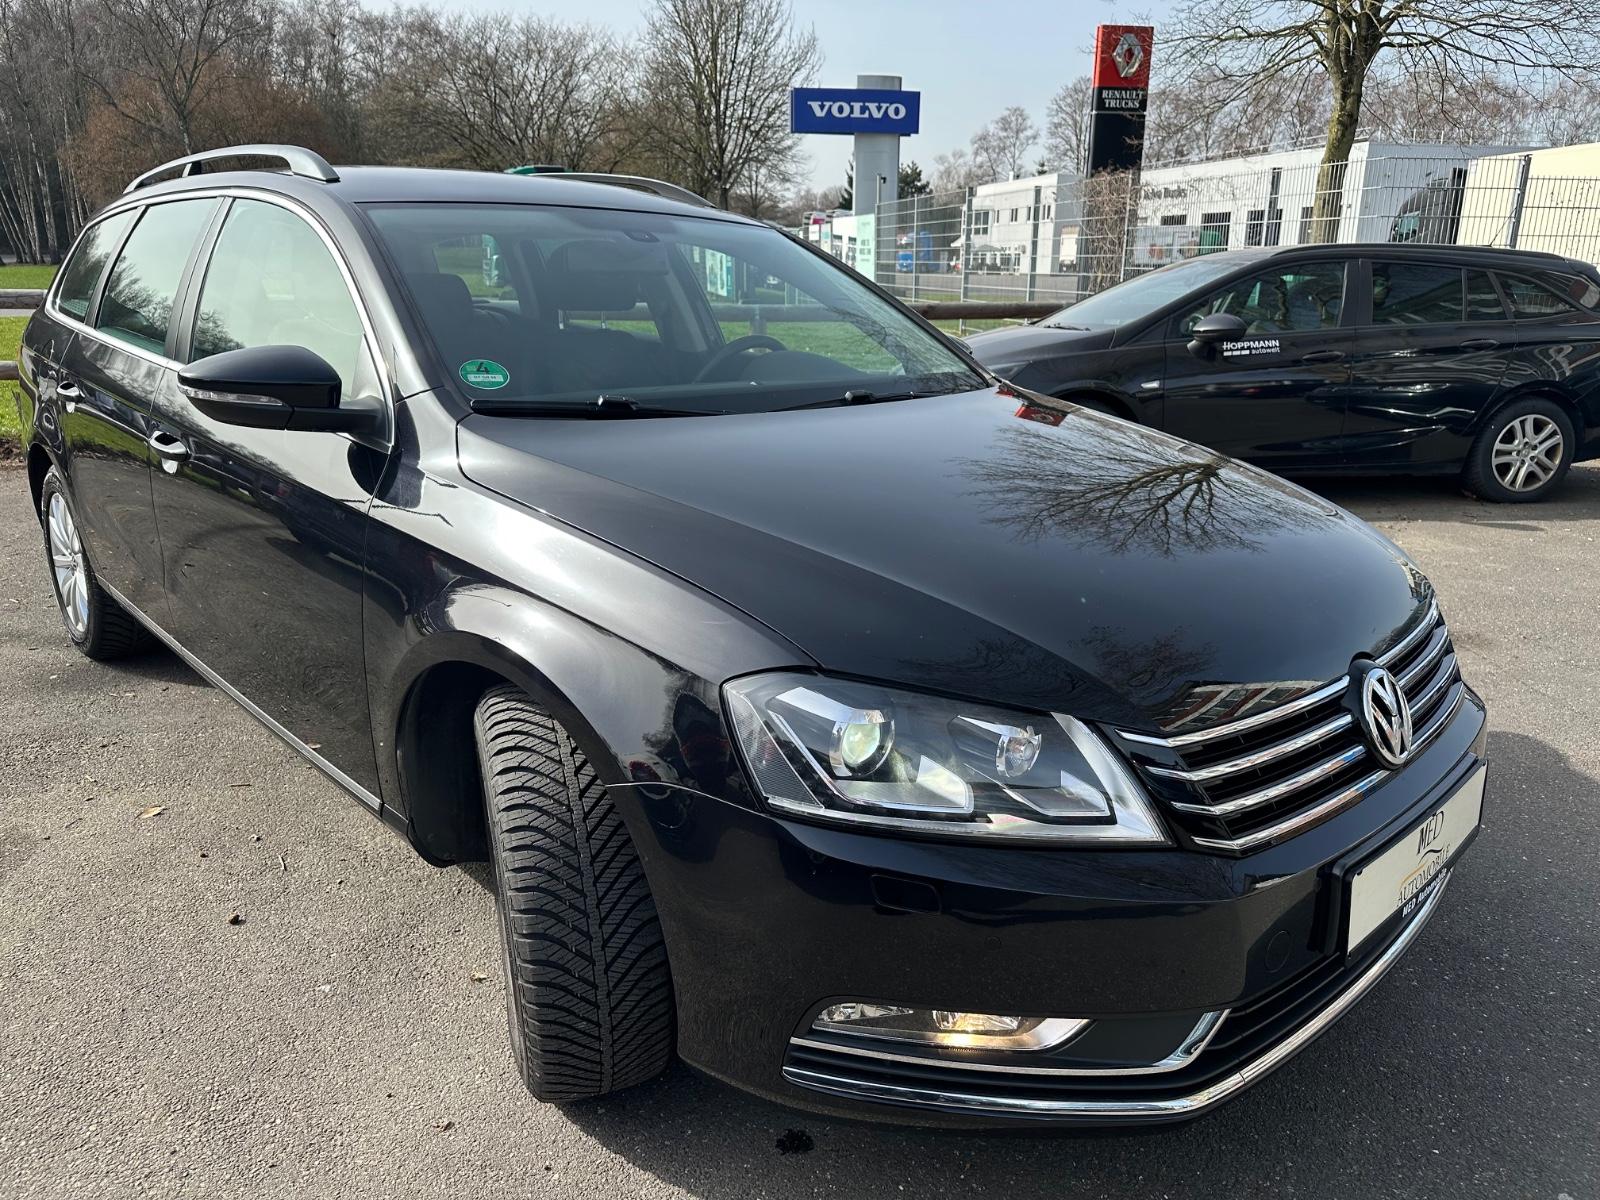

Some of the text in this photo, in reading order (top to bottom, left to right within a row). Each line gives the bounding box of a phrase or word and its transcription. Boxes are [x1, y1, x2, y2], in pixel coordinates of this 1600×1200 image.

[1101, 89, 1144, 99] RENAULT
[1104, 99, 1140, 108] TRUCKS
[807, 101, 907, 119] VOLVO
[1222, 340, 1280, 350] HOPPMANN
[1251, 347, 1280, 355] autowelt
[1416, 811, 1445, 855] MED
[1402, 898, 1416, 918] MED
